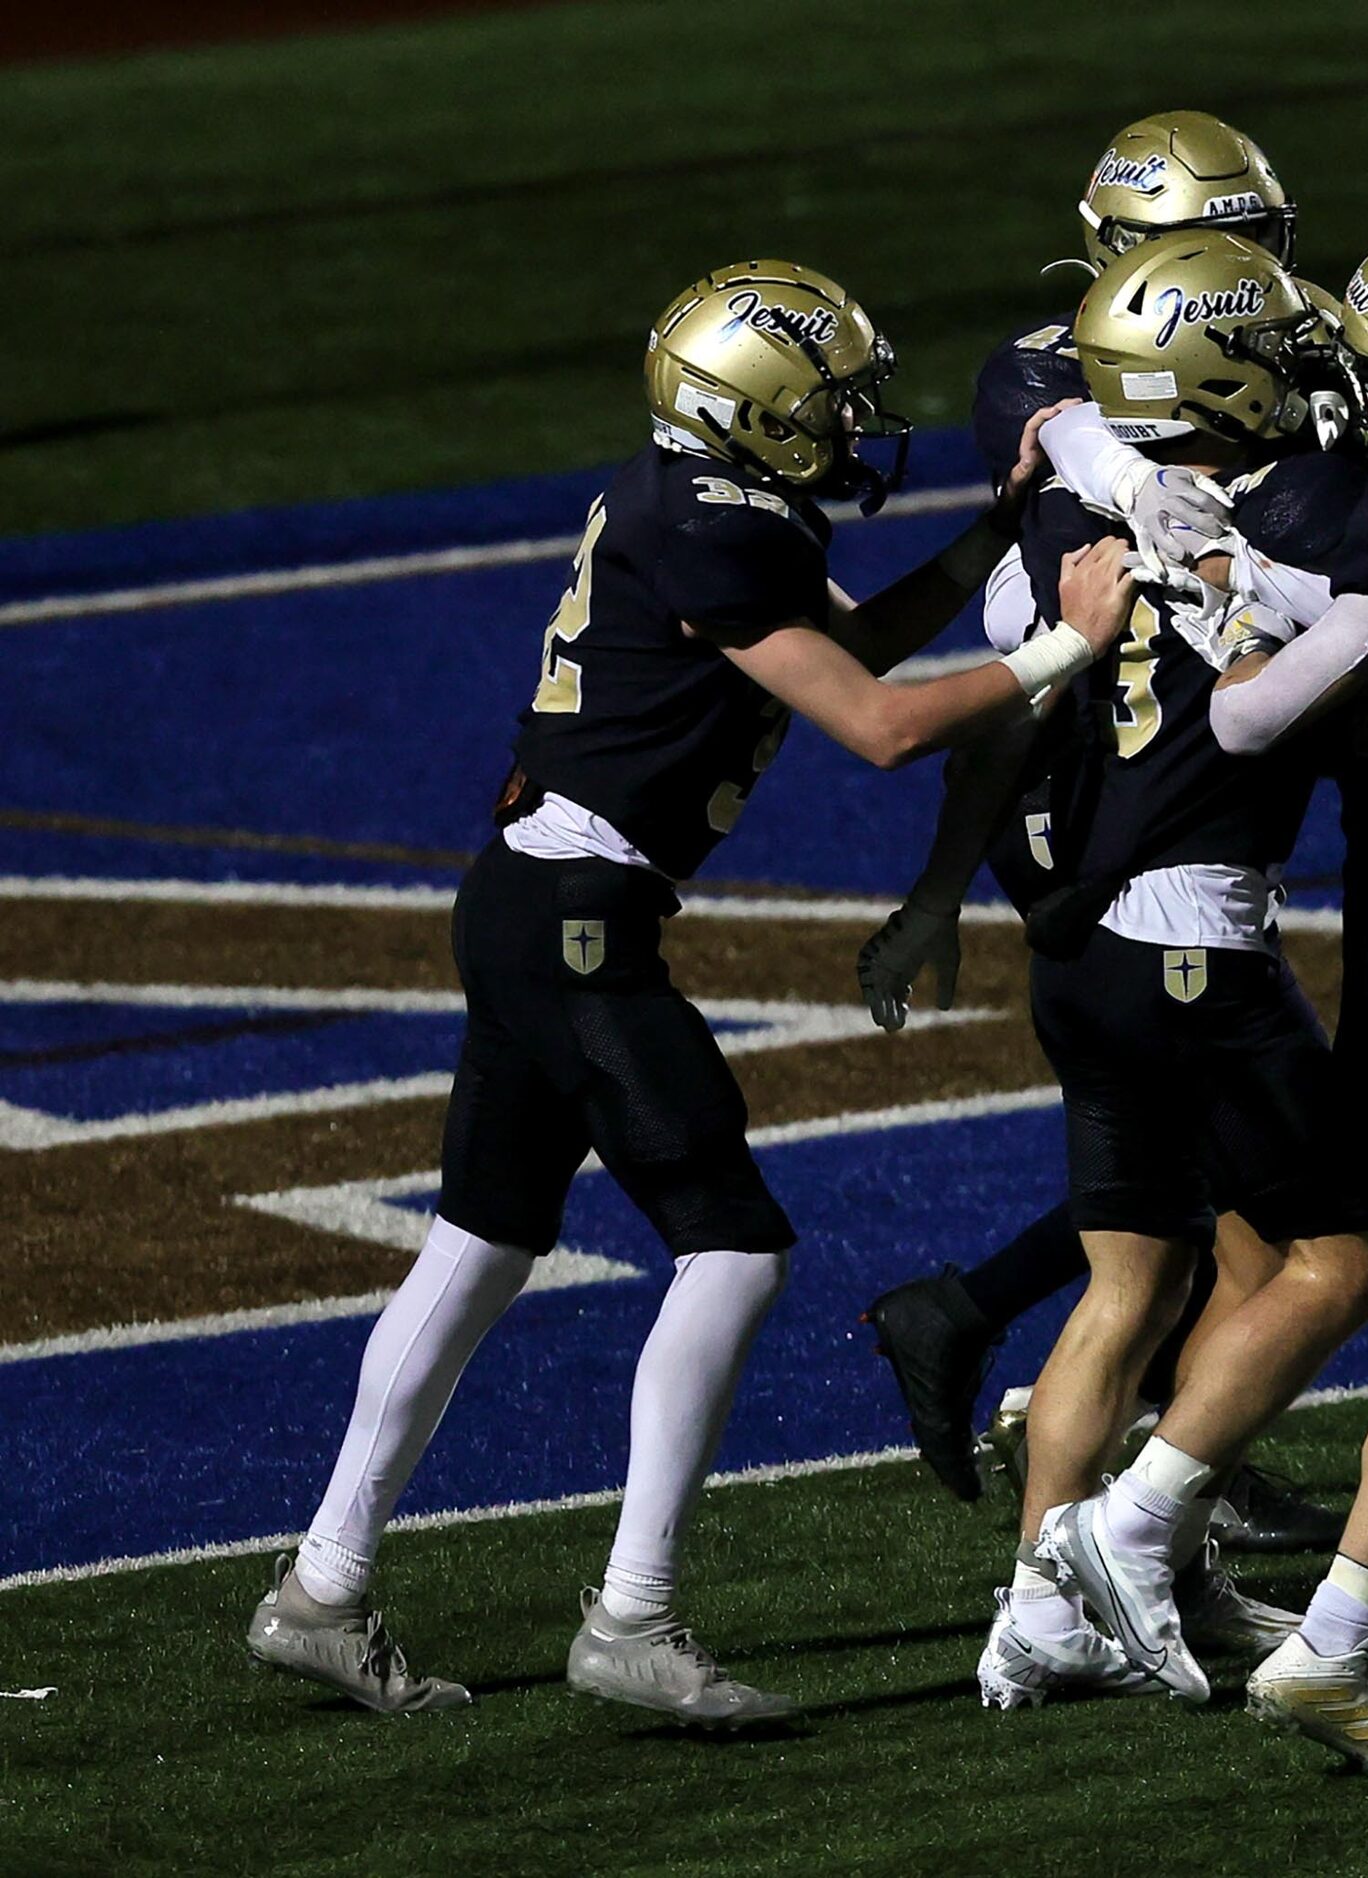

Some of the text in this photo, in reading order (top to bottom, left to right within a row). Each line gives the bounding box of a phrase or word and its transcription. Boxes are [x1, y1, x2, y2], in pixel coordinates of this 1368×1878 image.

[1089, 148, 1167, 194] Jesuit
[719, 290, 838, 344] Jesuit
[1154, 279, 1264, 350] Jesuit
